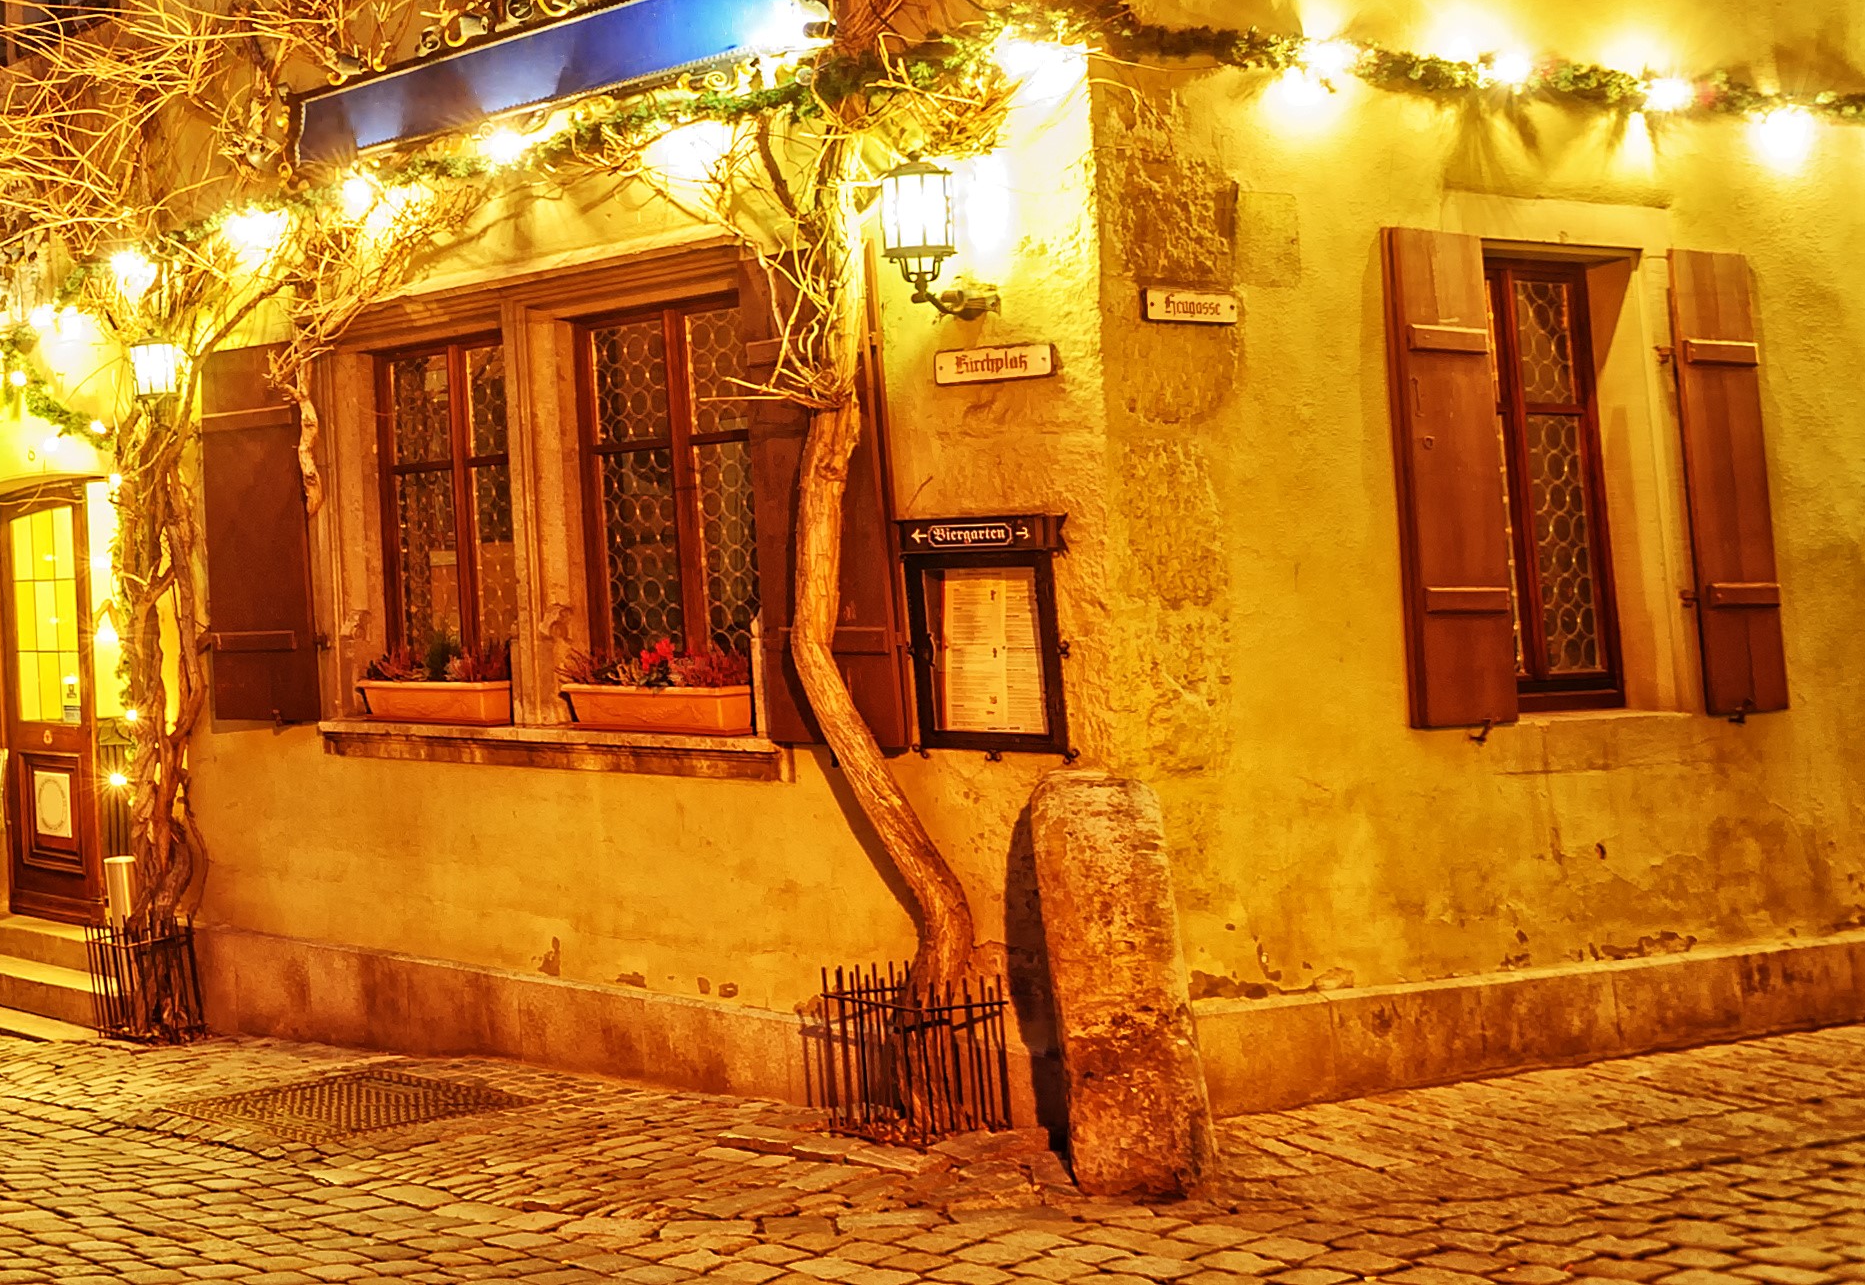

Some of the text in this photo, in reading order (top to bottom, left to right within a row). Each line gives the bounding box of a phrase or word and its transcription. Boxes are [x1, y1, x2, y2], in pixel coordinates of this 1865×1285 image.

[1164, 293, 1221, 318] Heugasse
[955, 350, 1028, 375] Kirchplatz
[932, 526, 1006, 544] Biergarten
